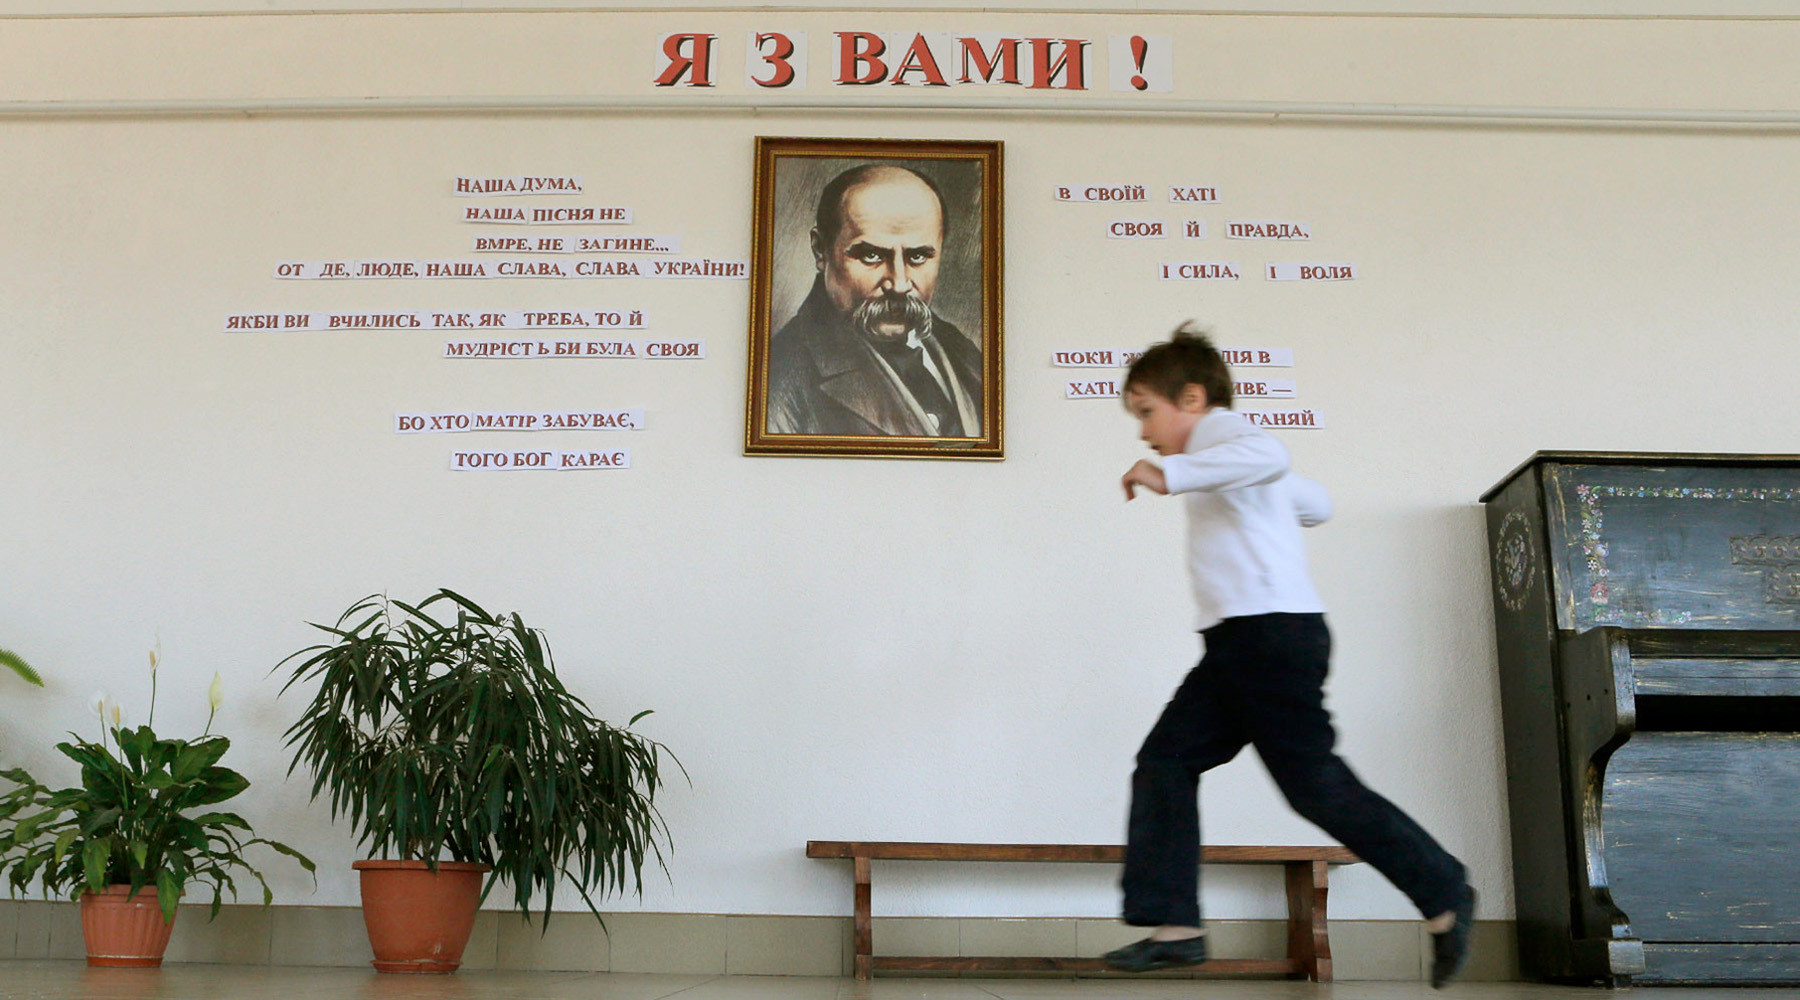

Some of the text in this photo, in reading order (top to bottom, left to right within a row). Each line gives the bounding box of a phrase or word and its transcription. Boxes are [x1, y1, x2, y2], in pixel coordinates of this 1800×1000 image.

[654, 33, 718, 87] Я
[751, 32, 795, 88] З
[833, 32, 1092, 90] ВАМИ
[457, 177, 582, 194] НАША ДУМА,
[1059, 185, 1216, 201] В СВОЇЙ ХАТІ
[466, 208, 625, 221] НАША ПІСНЯ НЕ
[1111, 221, 1308, 239] СВОЯ Й ПРАВДА,
[475, 238, 532, 252] ВМРЕ,
[537, 239, 563, 250] НЕ
[278, 259, 744, 278] ОТ ДЕ, ЛЮДЕ, НАША СЛАВА, СЛАВА УКРАЇНИ!
[1163, 265, 1353, 280] І СИЛА, І ВОЛЯ
[227, 311, 642, 328] ЯКБИ ВИ ВЧИЛИСЬ ТАК, ЯК ТРЕБА, ТО Й
[555, 343, 581, 355] БИ
[586, 343, 635, 356] БУЛА
[647, 344, 699, 356] СВОЯ
[1056, 351, 1112, 364] ПОКИ
[1222, 351, 1252, 365] ДІЯ
[1258, 351, 1270, 363] В
[1070, 382, 1119, 396] ХАТІ,
[1232, 382, 1267, 395] ИВЕ
[399, 413, 634, 430] БО ХТО МАТІР ЗАБУВАЄ,
[1242, 409, 1314, 425] ГАНЯЙ
[455, 452, 624, 467] ТОГО БОГ КАРАЄ
